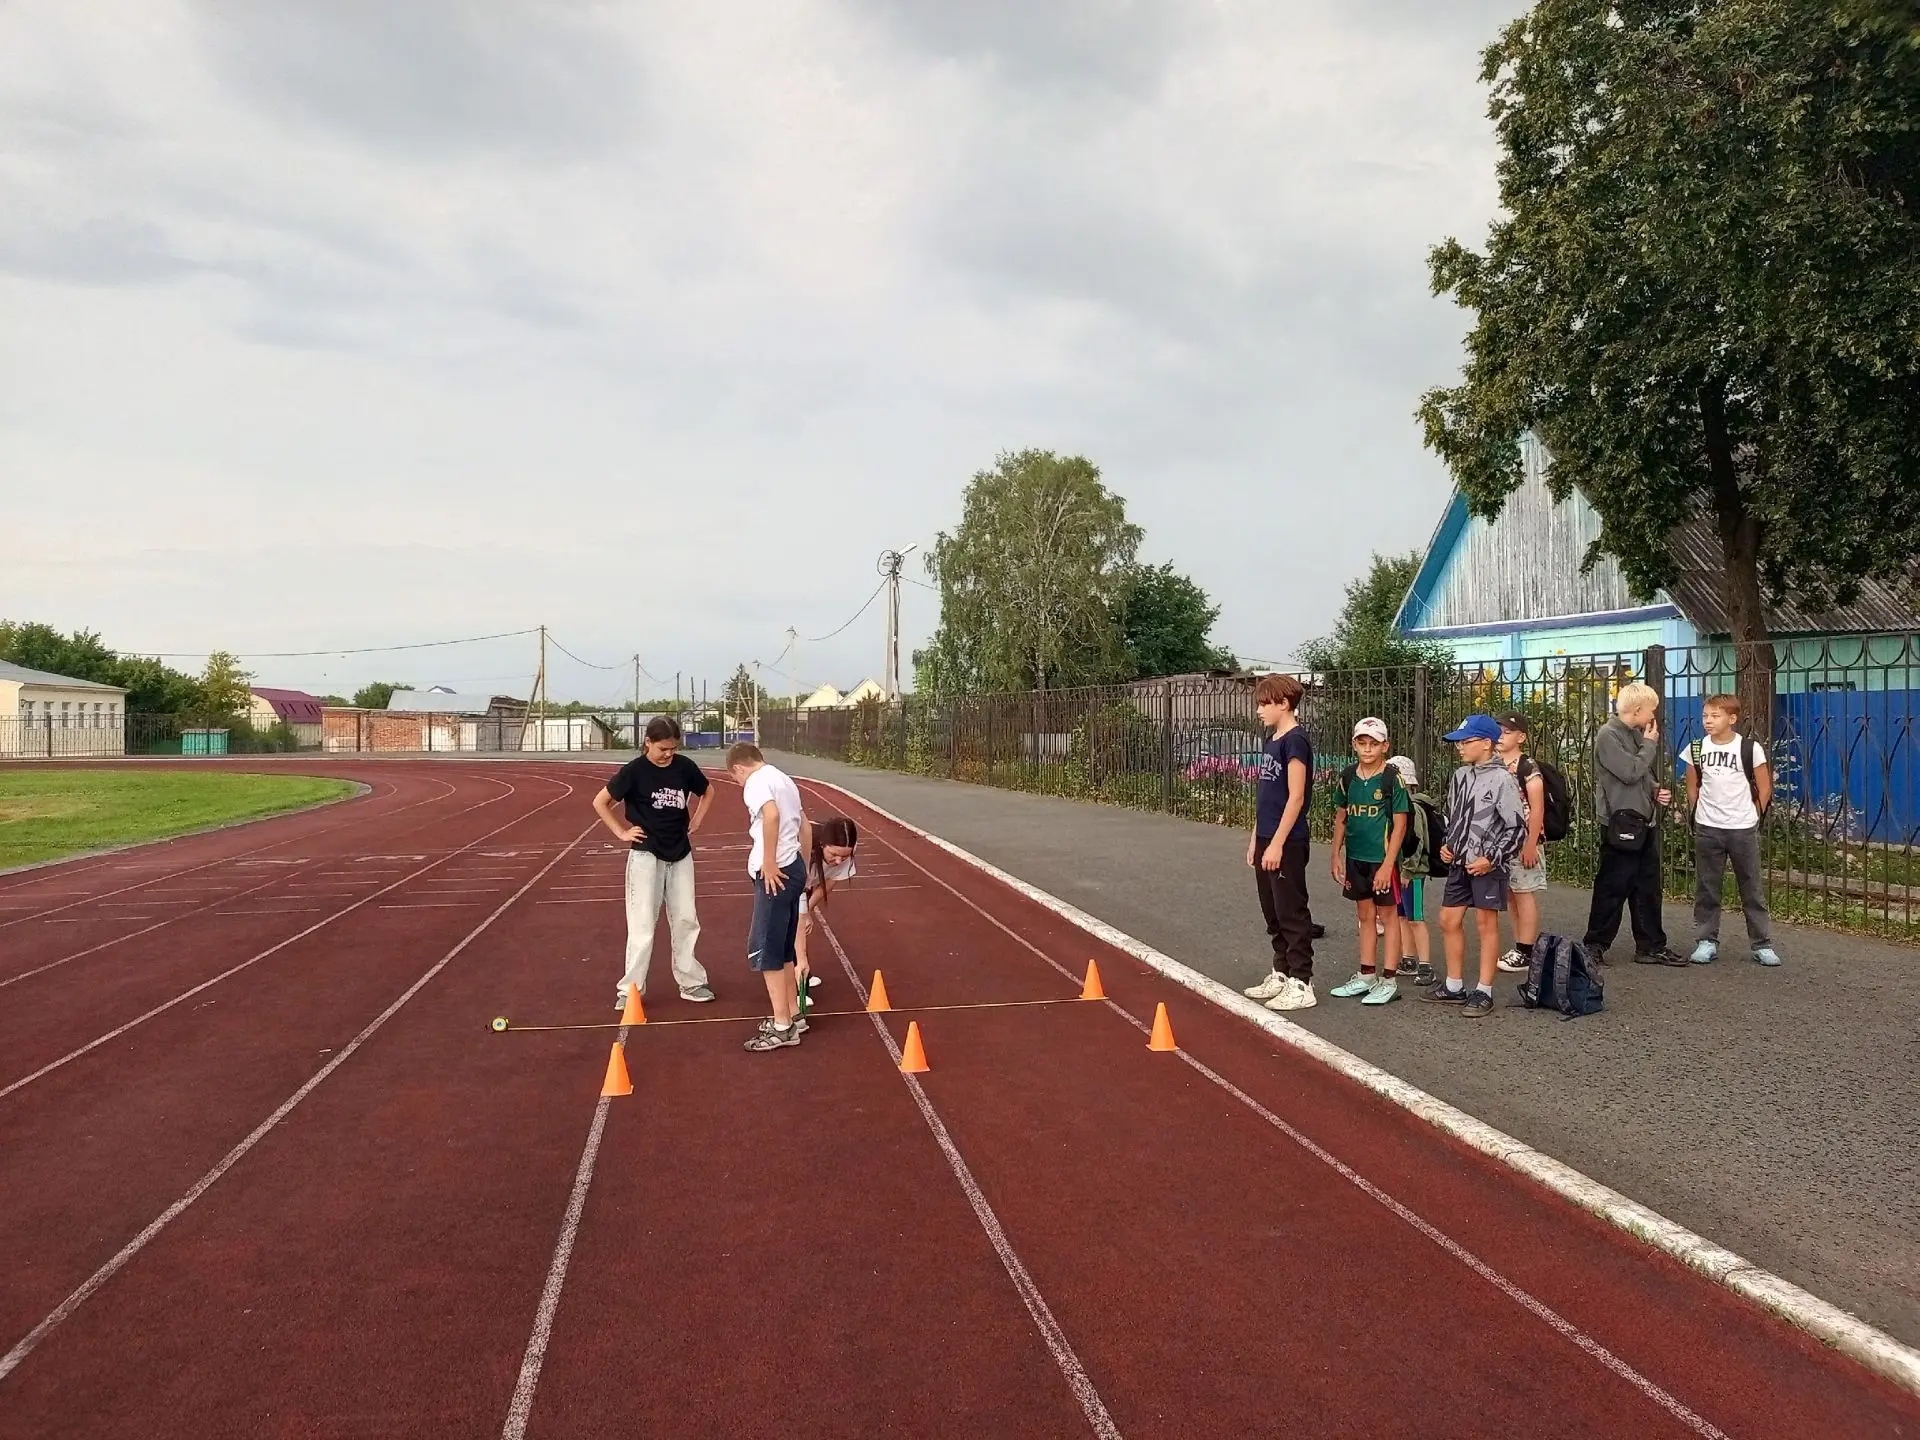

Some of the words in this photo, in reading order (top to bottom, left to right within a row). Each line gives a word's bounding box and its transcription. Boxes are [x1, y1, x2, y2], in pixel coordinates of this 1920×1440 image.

[1700, 751, 1739, 771] PUMA
[651, 792, 678, 802] NORTH
[657, 799, 677, 808] FACE
